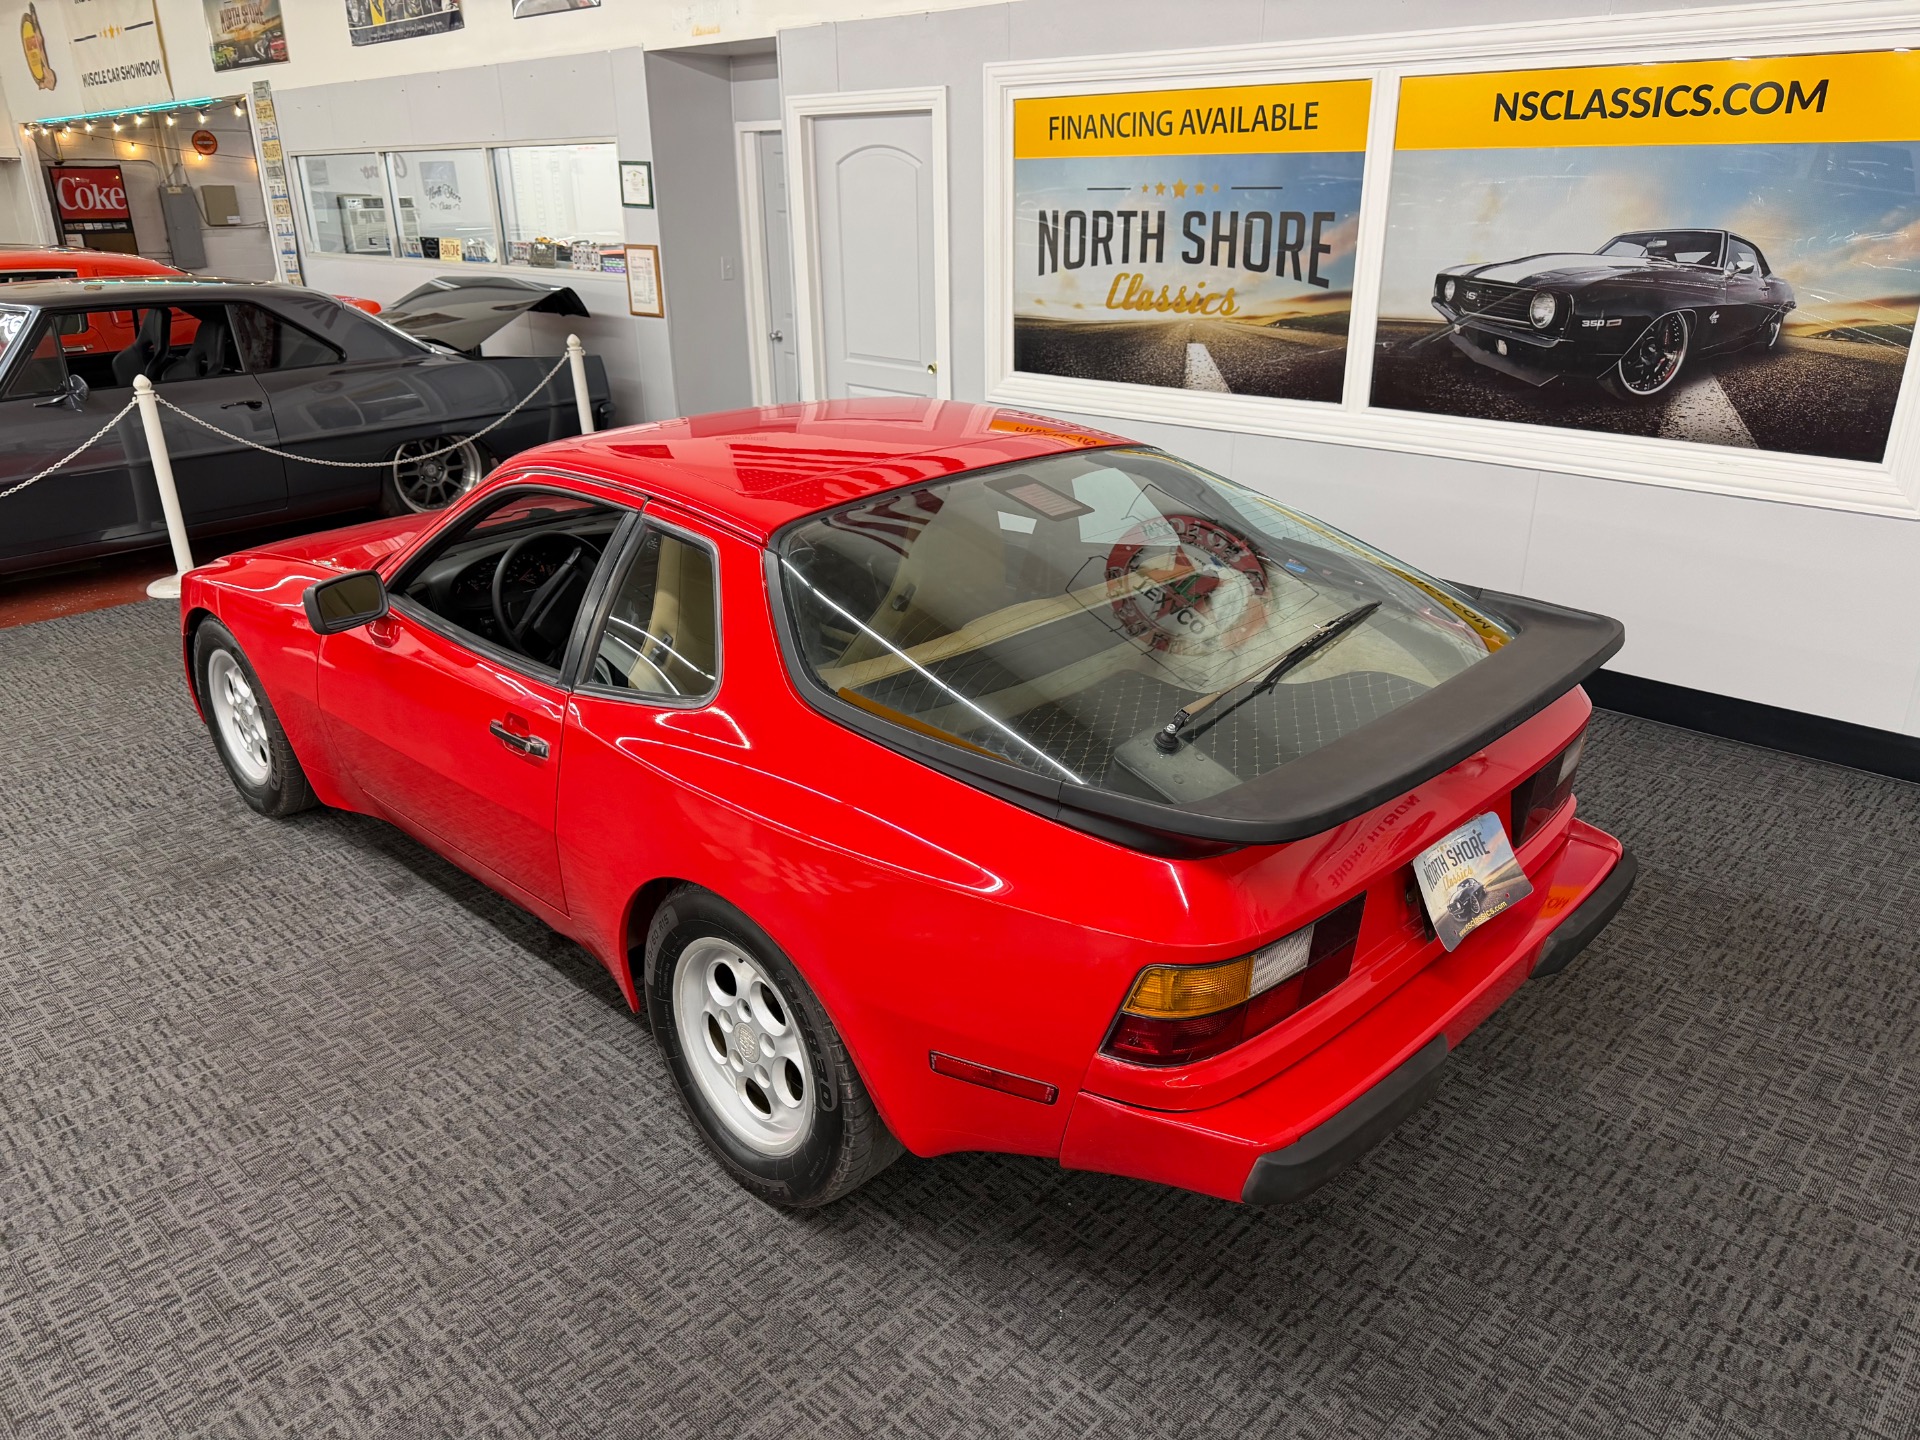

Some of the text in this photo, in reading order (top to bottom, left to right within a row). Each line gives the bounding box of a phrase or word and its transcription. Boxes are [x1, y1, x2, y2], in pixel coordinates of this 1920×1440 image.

[81, 69, 107, 88] MUSCLE
[106, 67, 121, 83] CAR
[1493, 79, 1830, 122] NSCLASSICS.COM
[1049, 101, 1320, 141] FINANCING AVAILABLE
[57, 176, 127, 210] Coke
[1037, 209, 1336, 289] NORTH SHORE
[1105, 272, 1241, 316] Classics
[1581, 319, 1605, 327] 350
[1423, 831, 1490, 892] NORTH SHORE
[1442, 865, 1474, 891] Classics
